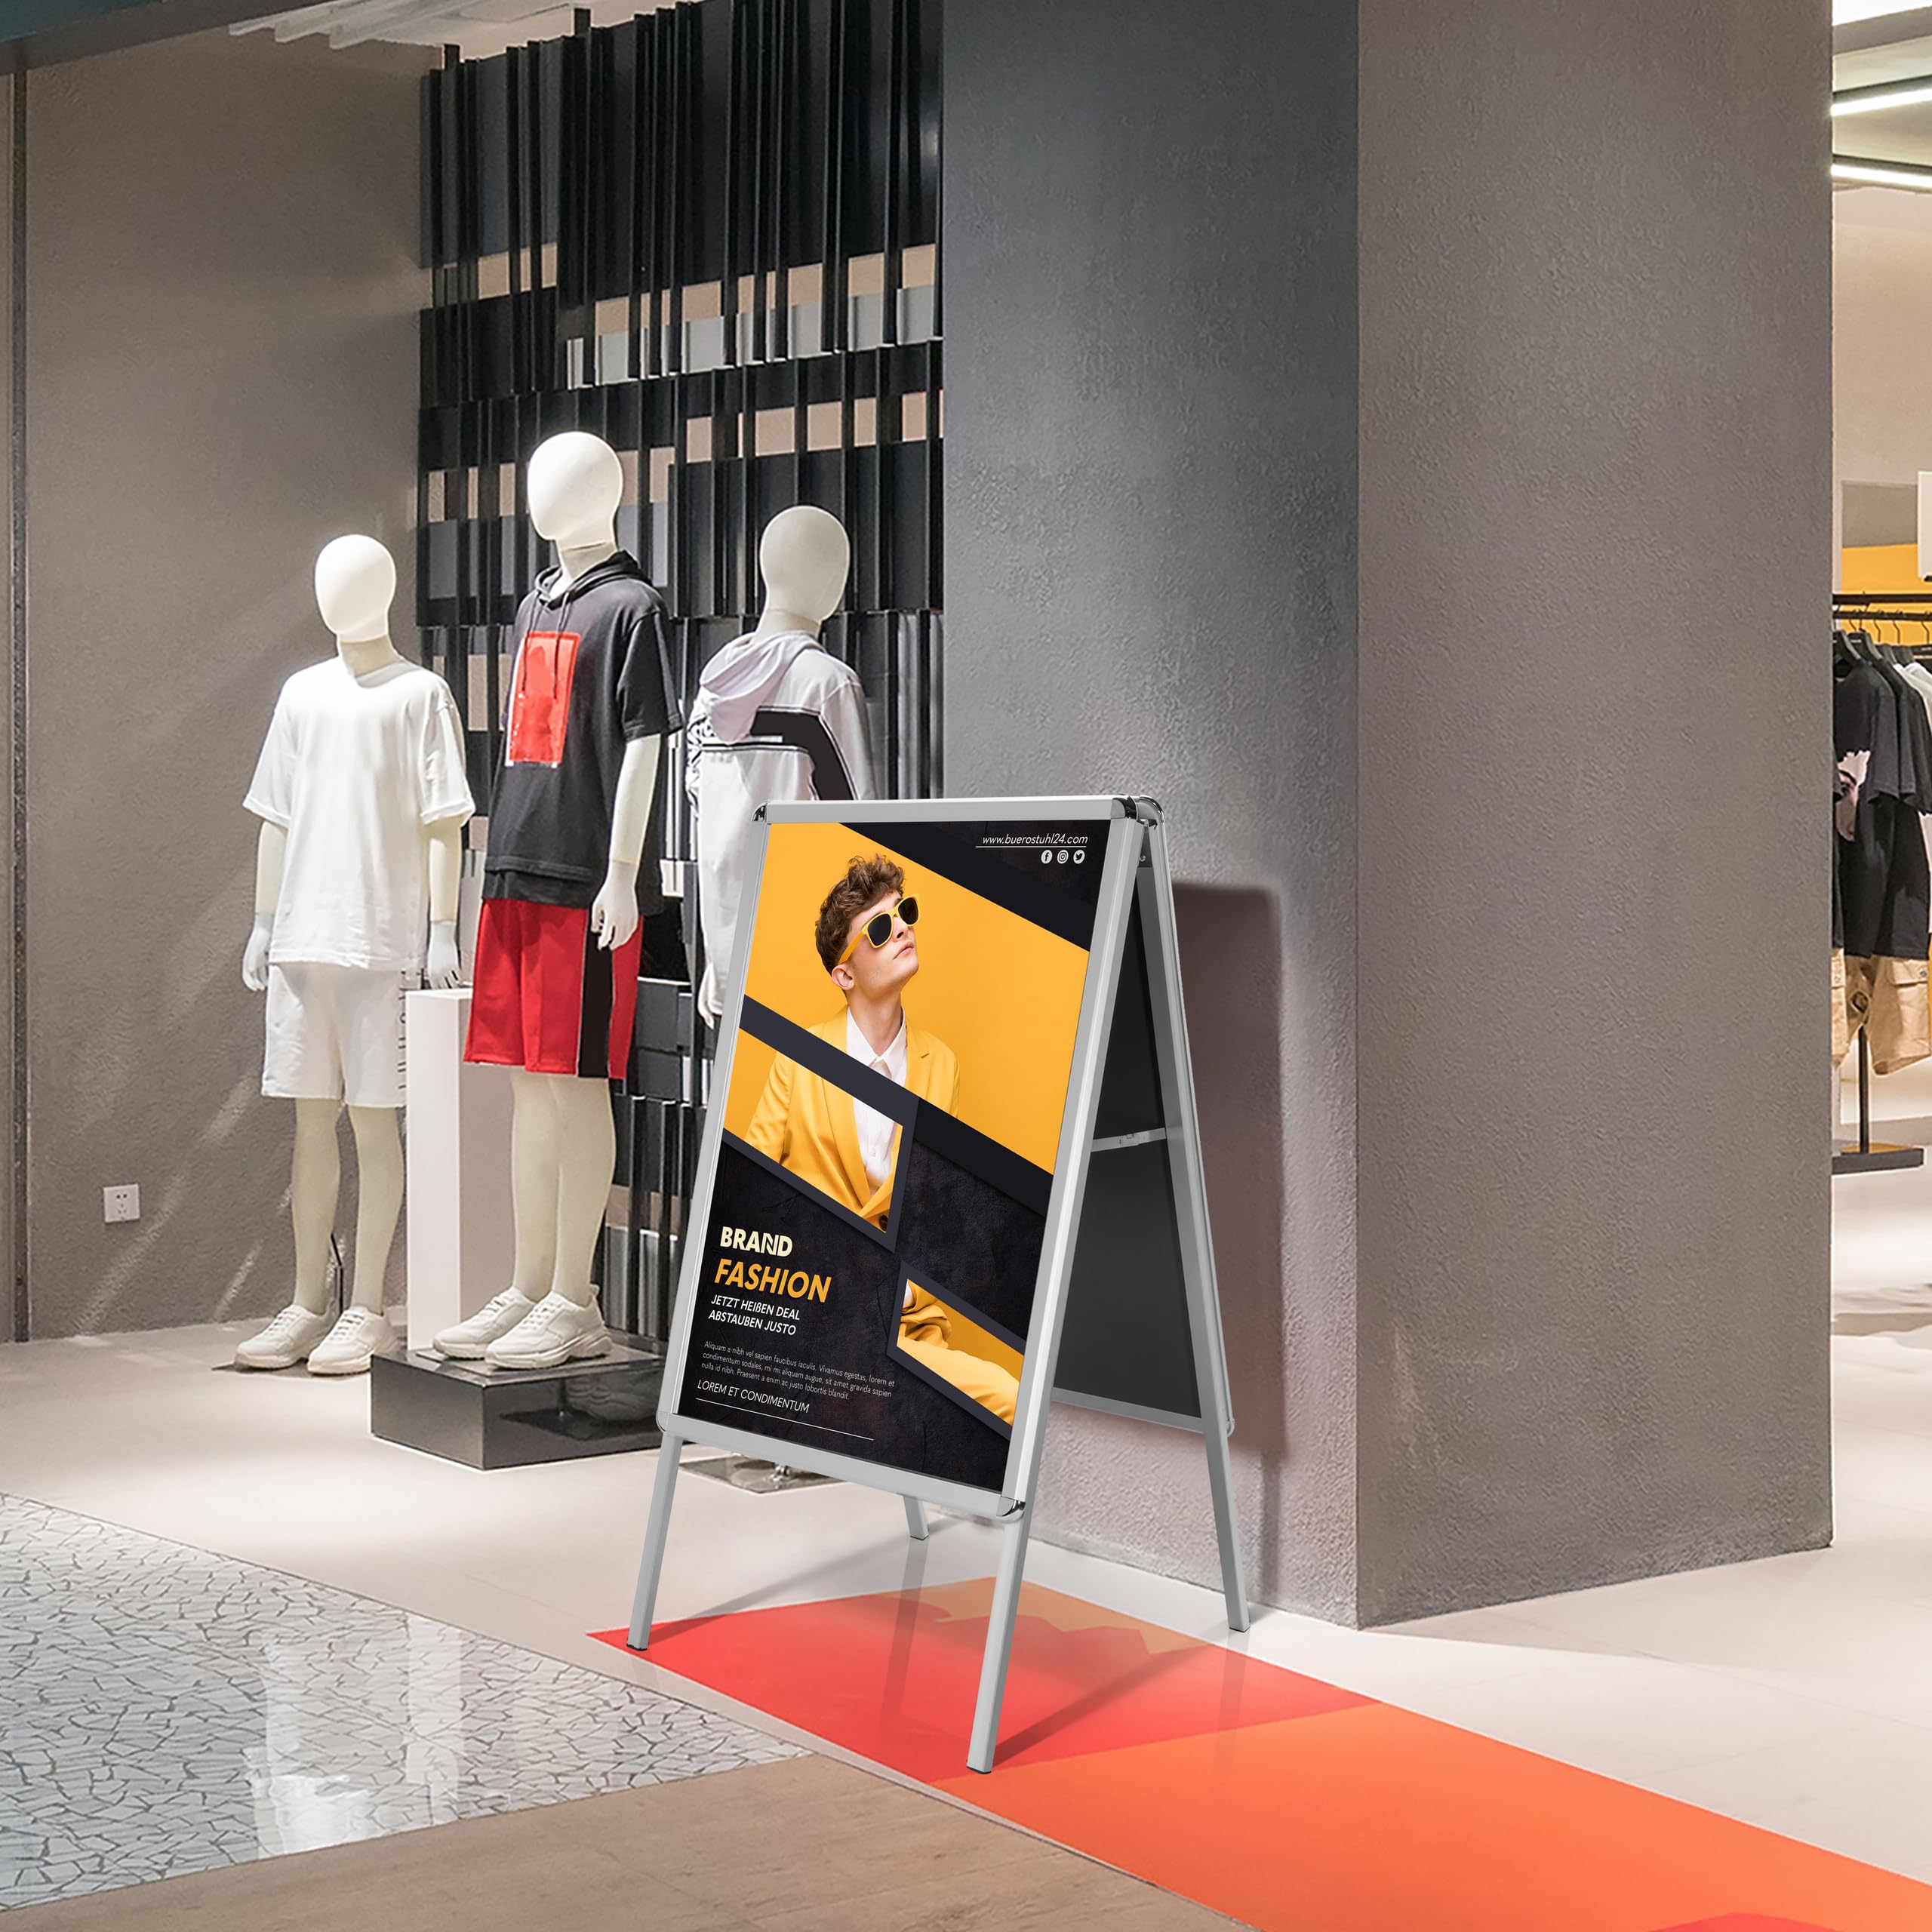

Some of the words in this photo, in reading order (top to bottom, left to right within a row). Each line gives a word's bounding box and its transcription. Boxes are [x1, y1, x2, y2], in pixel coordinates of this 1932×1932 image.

[983, 833, 1088, 844] www.buerostuhl24.com
[720, 1226, 792, 1257] BRAND
[714, 1258, 832, 1303] FASHION
[708, 1309, 763, 1330] ABSTAUBEN
[764, 1321, 796, 1336] JUSTO
[711, 1294, 740, 1309] JETZT
[740, 1300, 775, 1315] HEIßEN
[776, 1306, 800, 1321] DEAL
[703, 1352, 740, 1365] condimentum
[741, 1361, 763, 1371] sodales,
[781, 1369, 804, 1378] aliquam
[804, 1374, 823, 1384] augue,
[833, 1380, 848, 1389] amet
[850, 1384, 871, 1393] gravida
[872, 1388, 892, 1398] sapien
[704, 1341, 726, 1352] Aliquam
[732, 1347, 744, 1355] nibh
[755, 1352, 772, 1361] sapien
[774, 1355, 797, 1367] faucibus
[819, 1364, 843, 1376] Vivamus
[844, 1371, 867, 1382] egestas,
[869, 1374, 887, 1386] lorem
[697, 1380, 727, 1394] LOREM
[728, 1386, 740, 1397] ET
[740, 1389, 810, 1414] CONDIMENTUM
[701, 1362, 714, 1371] nulla
[721, 1366, 735, 1375] nibh.
[737, 1368, 760, 1380] Praesent
[789, 1380, 804, 1389] justo
[804, 1383, 826, 1395] lobortis
[828, 1389, 850, 1400] blandit.
